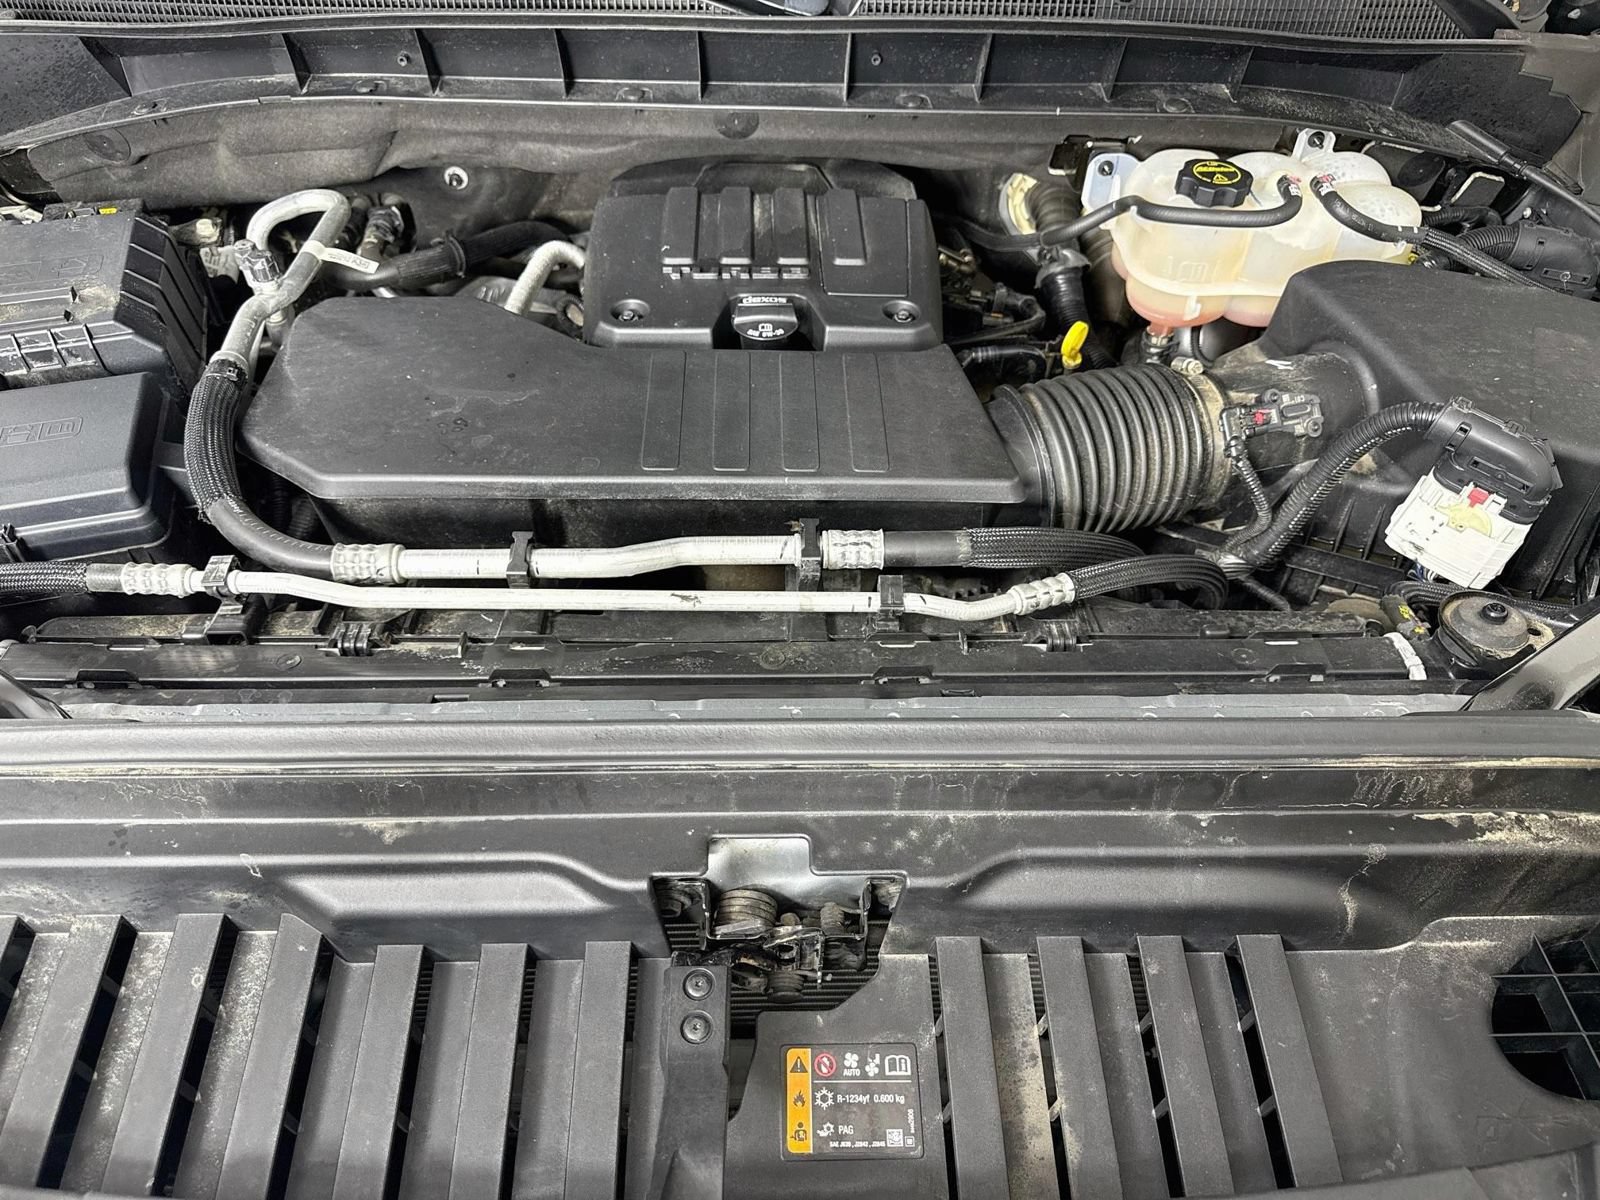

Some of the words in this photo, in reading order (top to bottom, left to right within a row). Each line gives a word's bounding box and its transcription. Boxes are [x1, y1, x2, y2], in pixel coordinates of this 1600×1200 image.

[742, 295, 787, 304] dexos
[843, 1068, 861, 1076] AUTO
[837, 1094, 870, 1104] R-1234yf
[873, 1094, 894, 1103] 0.600
[895, 1094, 905, 1105] kg
[838, 1125, 854, 1135] PAG
